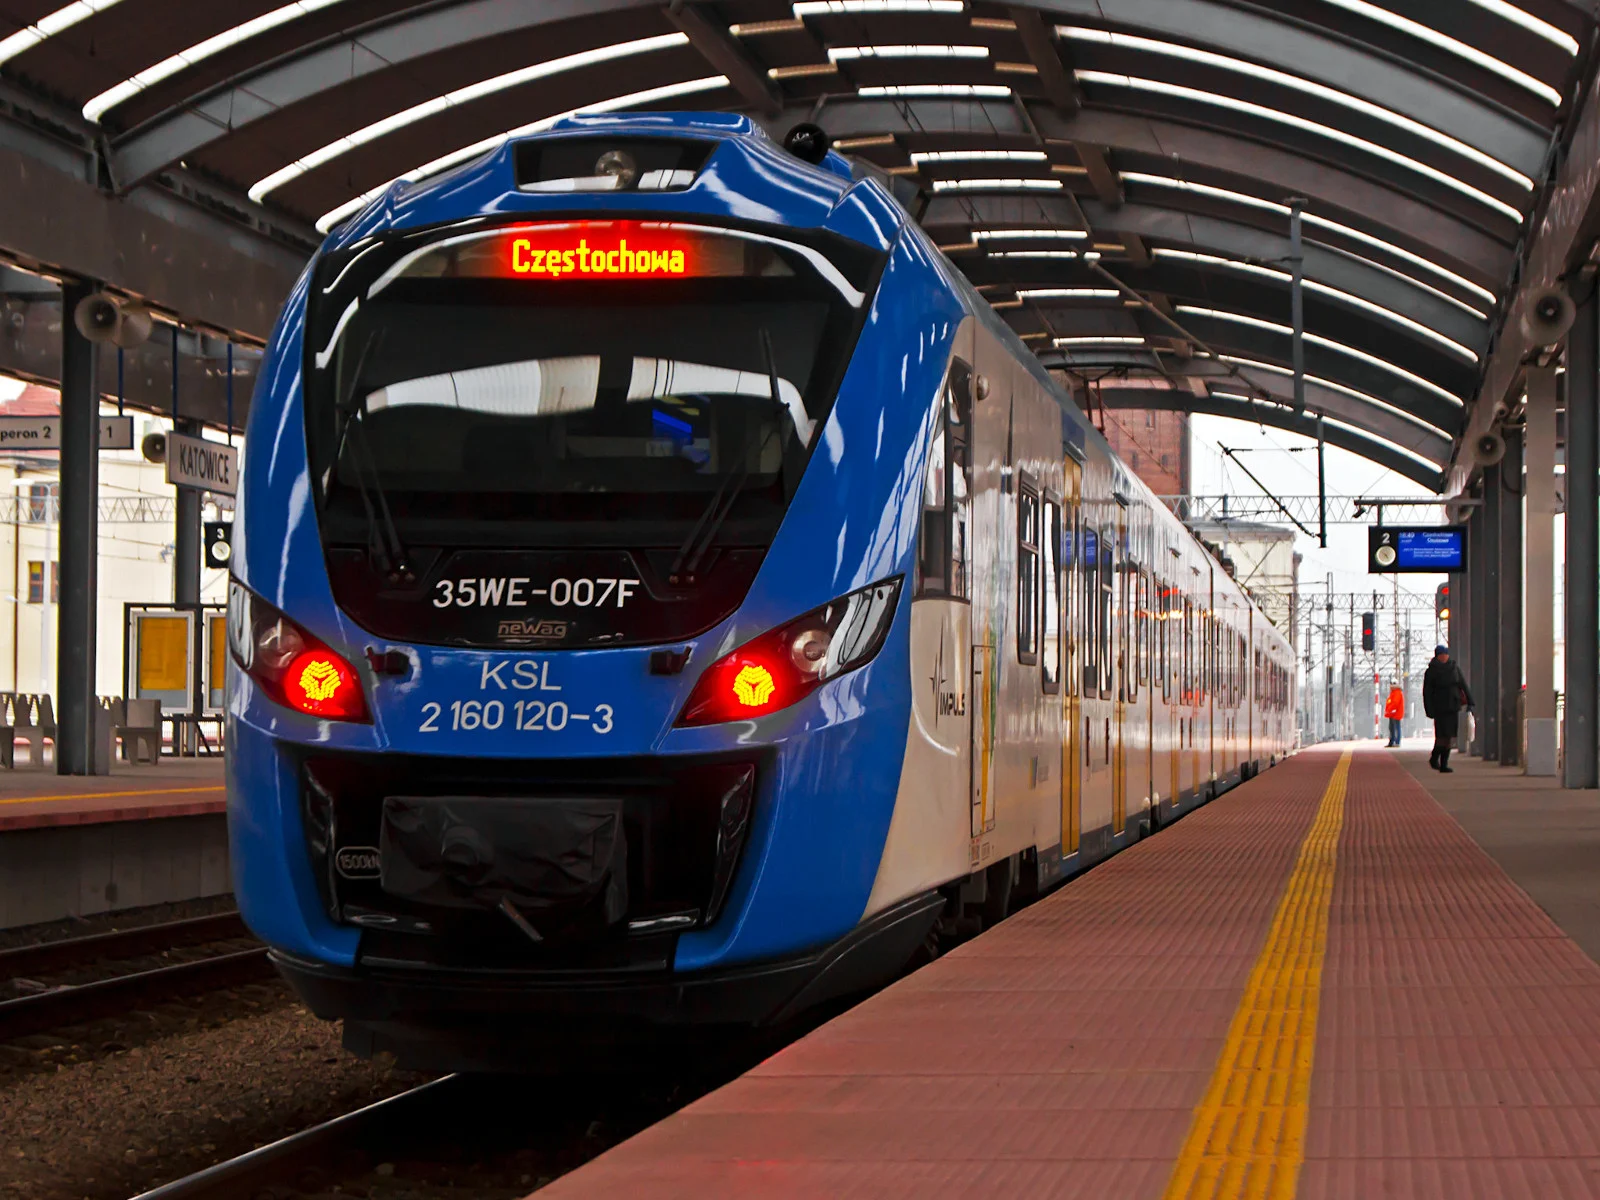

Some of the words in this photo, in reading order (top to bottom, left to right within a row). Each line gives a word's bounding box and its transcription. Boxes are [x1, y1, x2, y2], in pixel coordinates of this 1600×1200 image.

[512, 239, 685, 277] Częstochowa
[0, 427, 38, 441] peron
[42, 425, 51, 439] 2
[106, 425, 113, 438] 1
[179, 443, 229, 485] KATOWICE
[217, 528, 224, 539] 3
[1382, 532, 1390, 544] 2
[432, 577, 640, 609] 35WE-007F
[480, 660, 562, 690] KSL
[418, 701, 442, 733] 2
[450, 699, 505, 731] 160
[513, 699, 614, 734] 120-3
